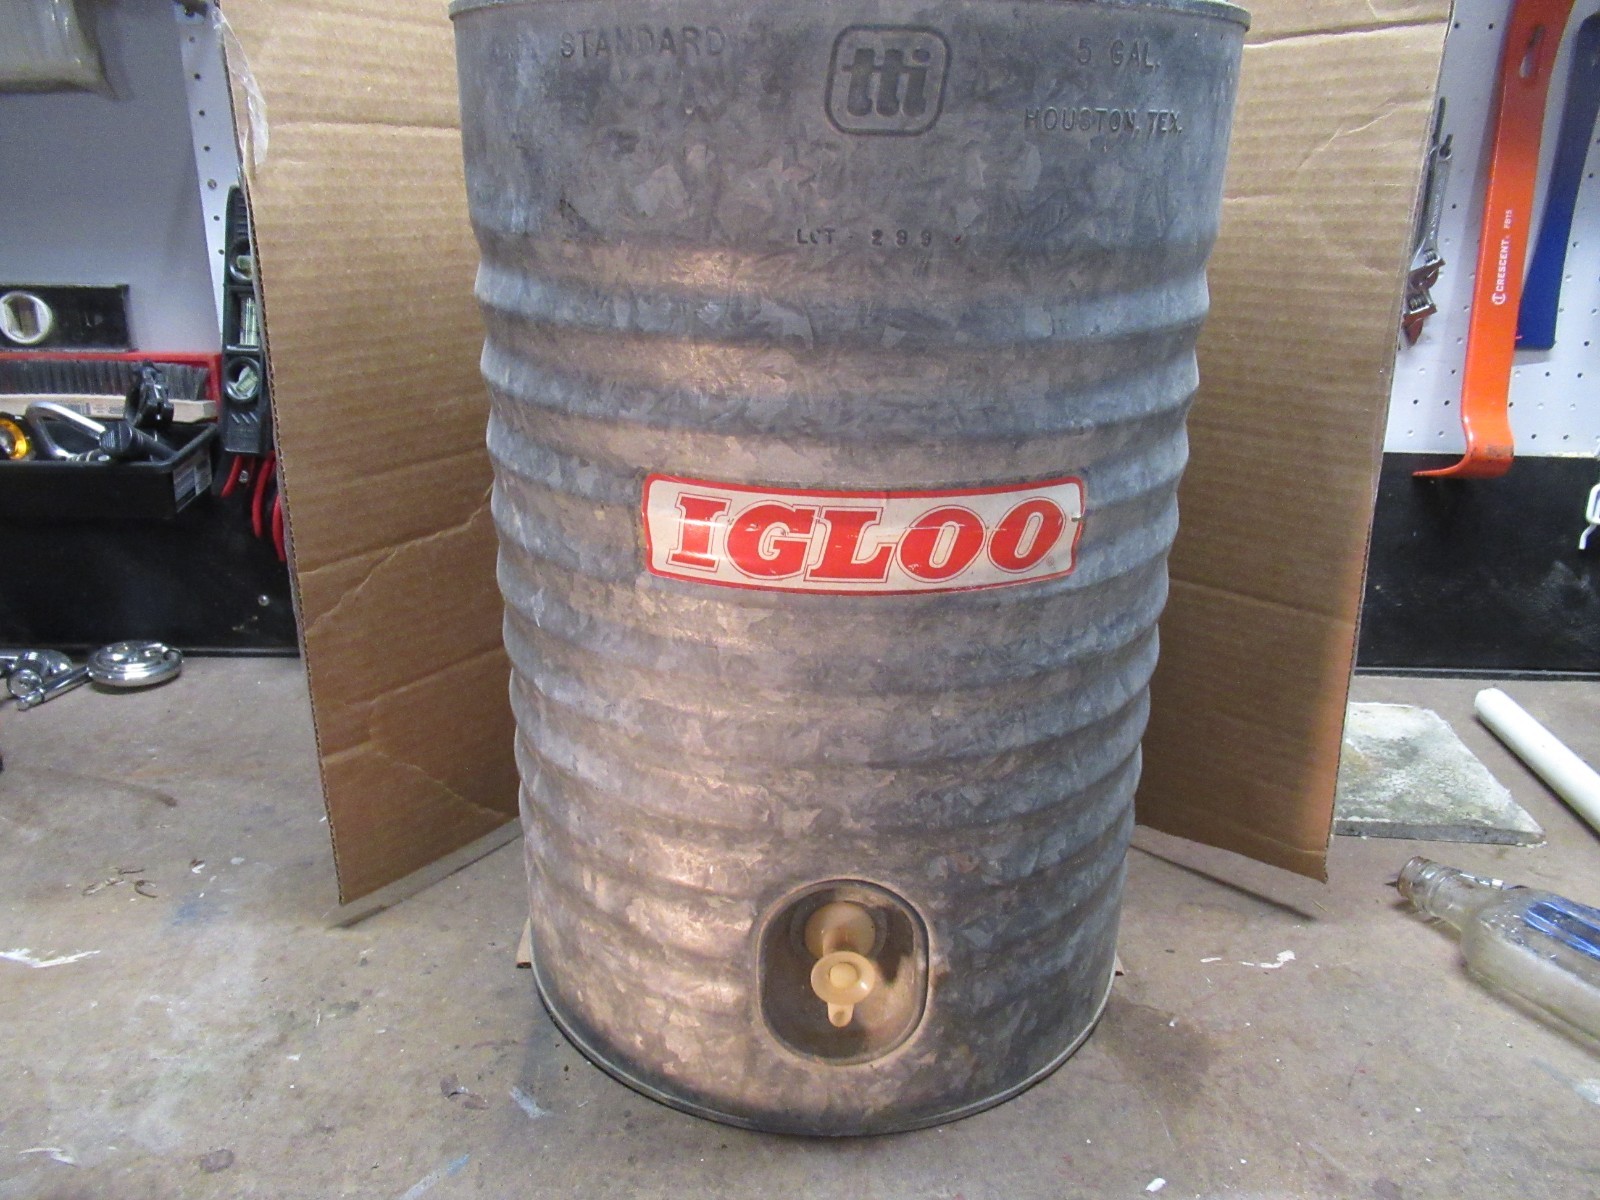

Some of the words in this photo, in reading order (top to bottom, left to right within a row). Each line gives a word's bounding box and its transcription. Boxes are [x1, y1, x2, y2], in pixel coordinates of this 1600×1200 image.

[558, 26, 727, 58] STANDARD
[1077, 37, 1092, 66] 5
[1110, 39, 1161, 68] GAL.
[1147, 109, 1183, 134] TEX.
[1495, 239, 1511, 292] CRESCENT
[1503, 209, 1512, 229] FB15
[666, 492, 1066, 583] IGLOO
